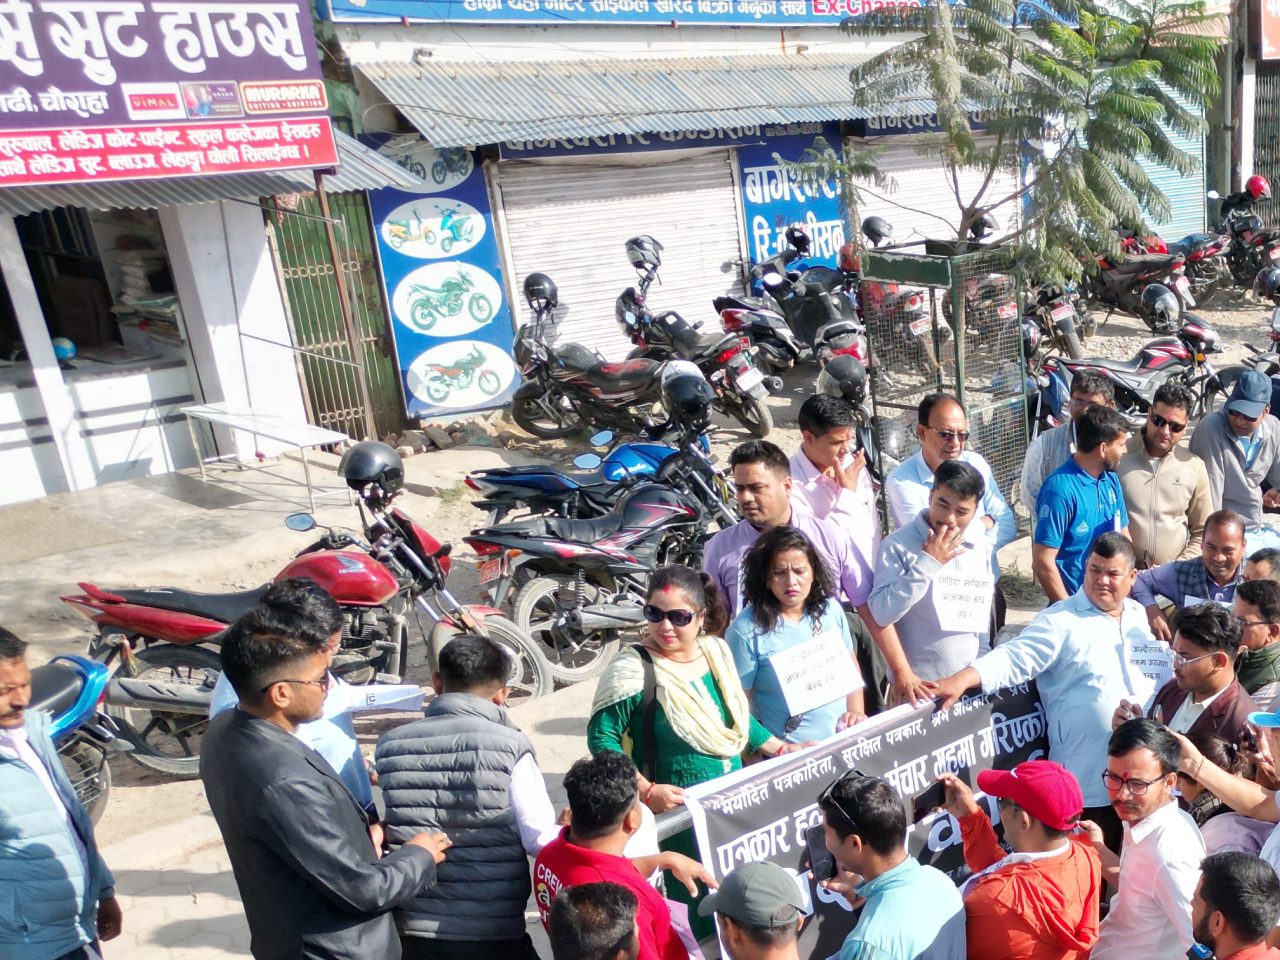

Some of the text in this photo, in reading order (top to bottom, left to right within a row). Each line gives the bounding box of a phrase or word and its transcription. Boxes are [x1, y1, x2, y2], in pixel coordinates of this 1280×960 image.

[40, 1, 149, 86] सुट
[149, 3, 309, 74] हाउस
[133, 98, 176, 109] VIMAL
[773, 755, 837, 792] पत्रकारिता,
[841, 734, 883, 769] सुरक्षित
[885, 717, 927, 745] पत्रकार,
